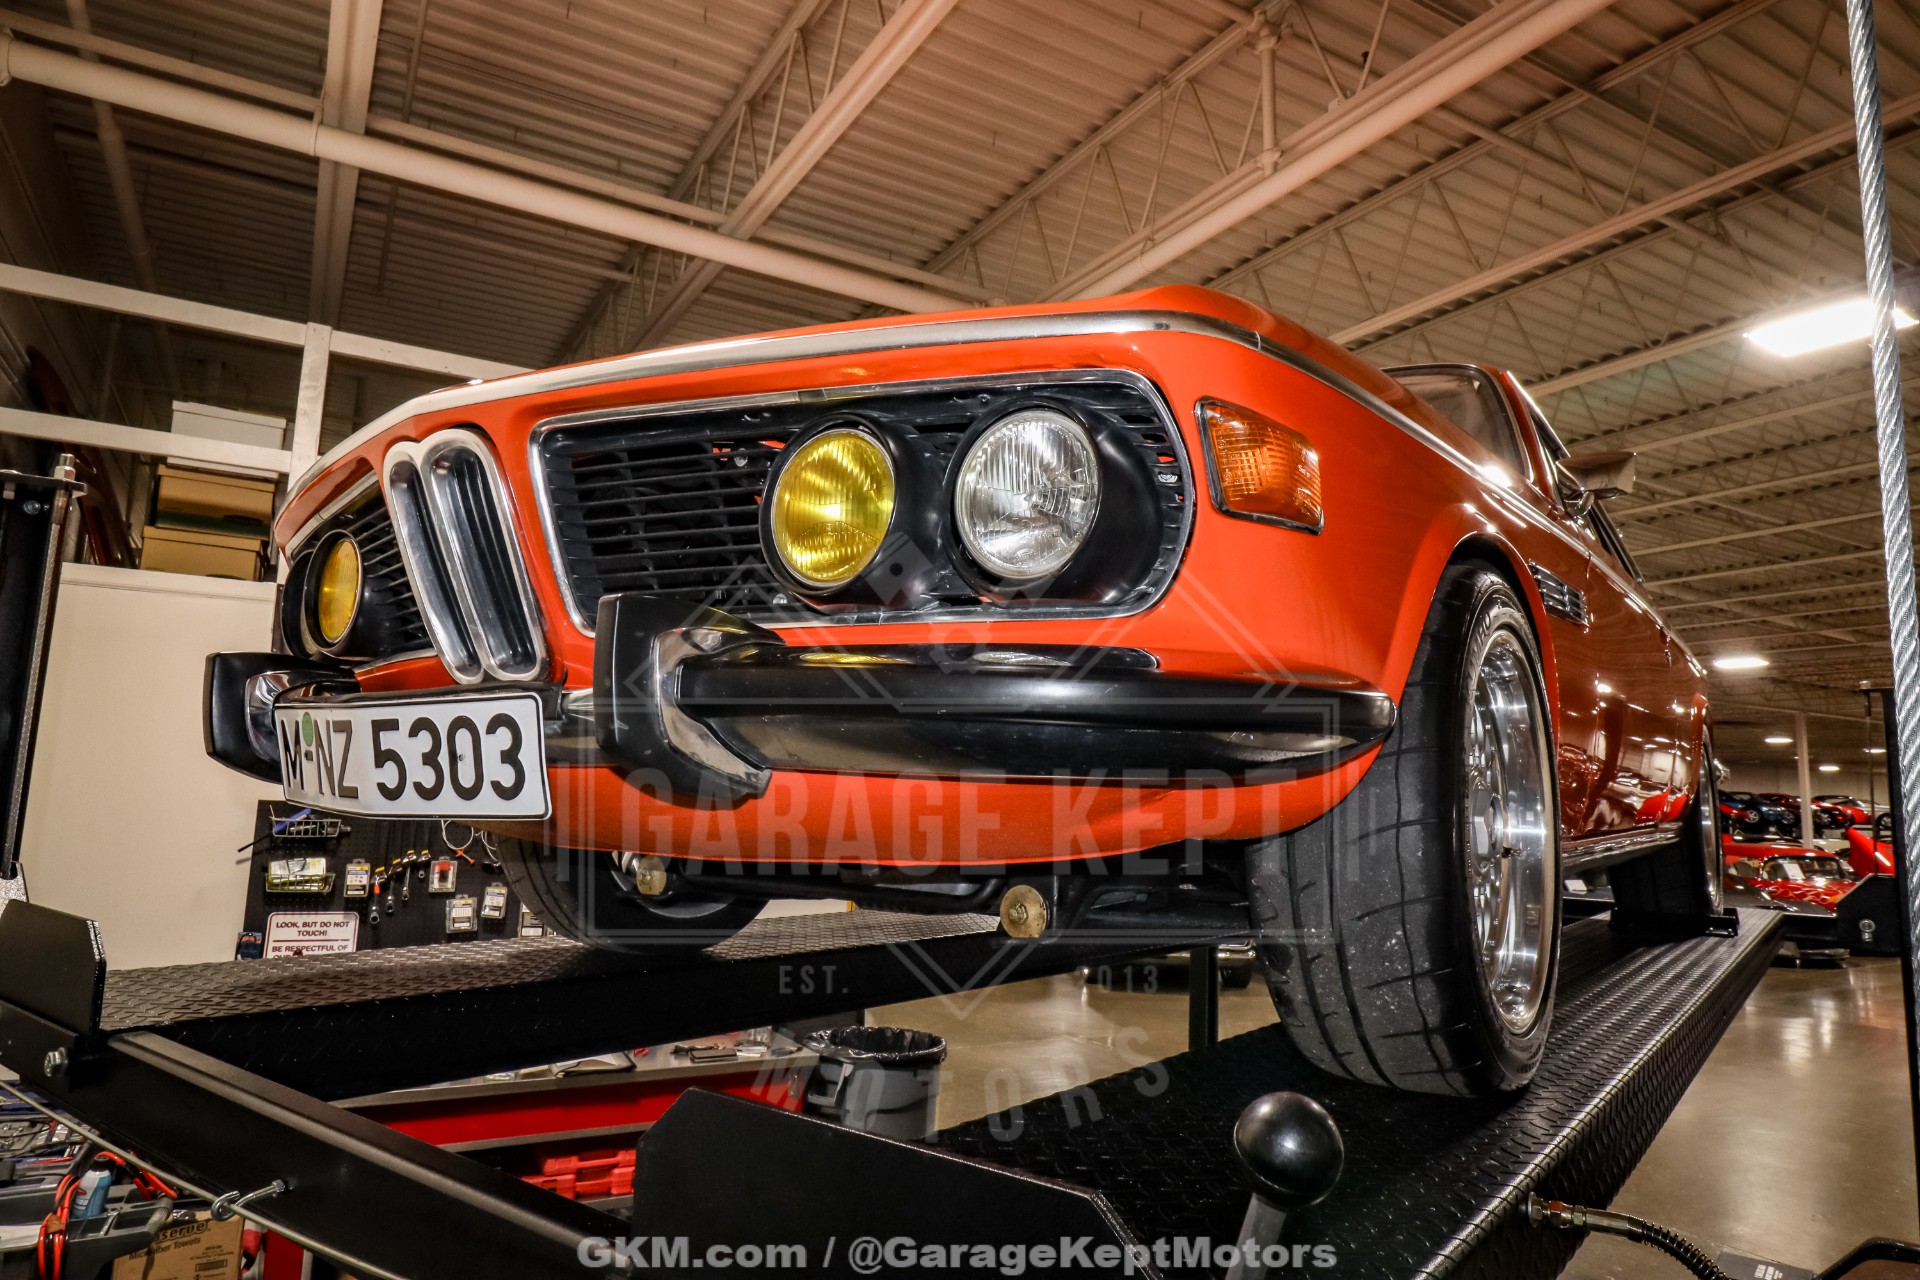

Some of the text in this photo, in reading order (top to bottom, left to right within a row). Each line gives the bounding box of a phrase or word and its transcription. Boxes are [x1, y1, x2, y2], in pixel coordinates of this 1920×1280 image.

[371, 713, 525, 801] 5303
[276, 921, 299, 929] LOOK,
[173, 1235, 201, 1250] Towels
